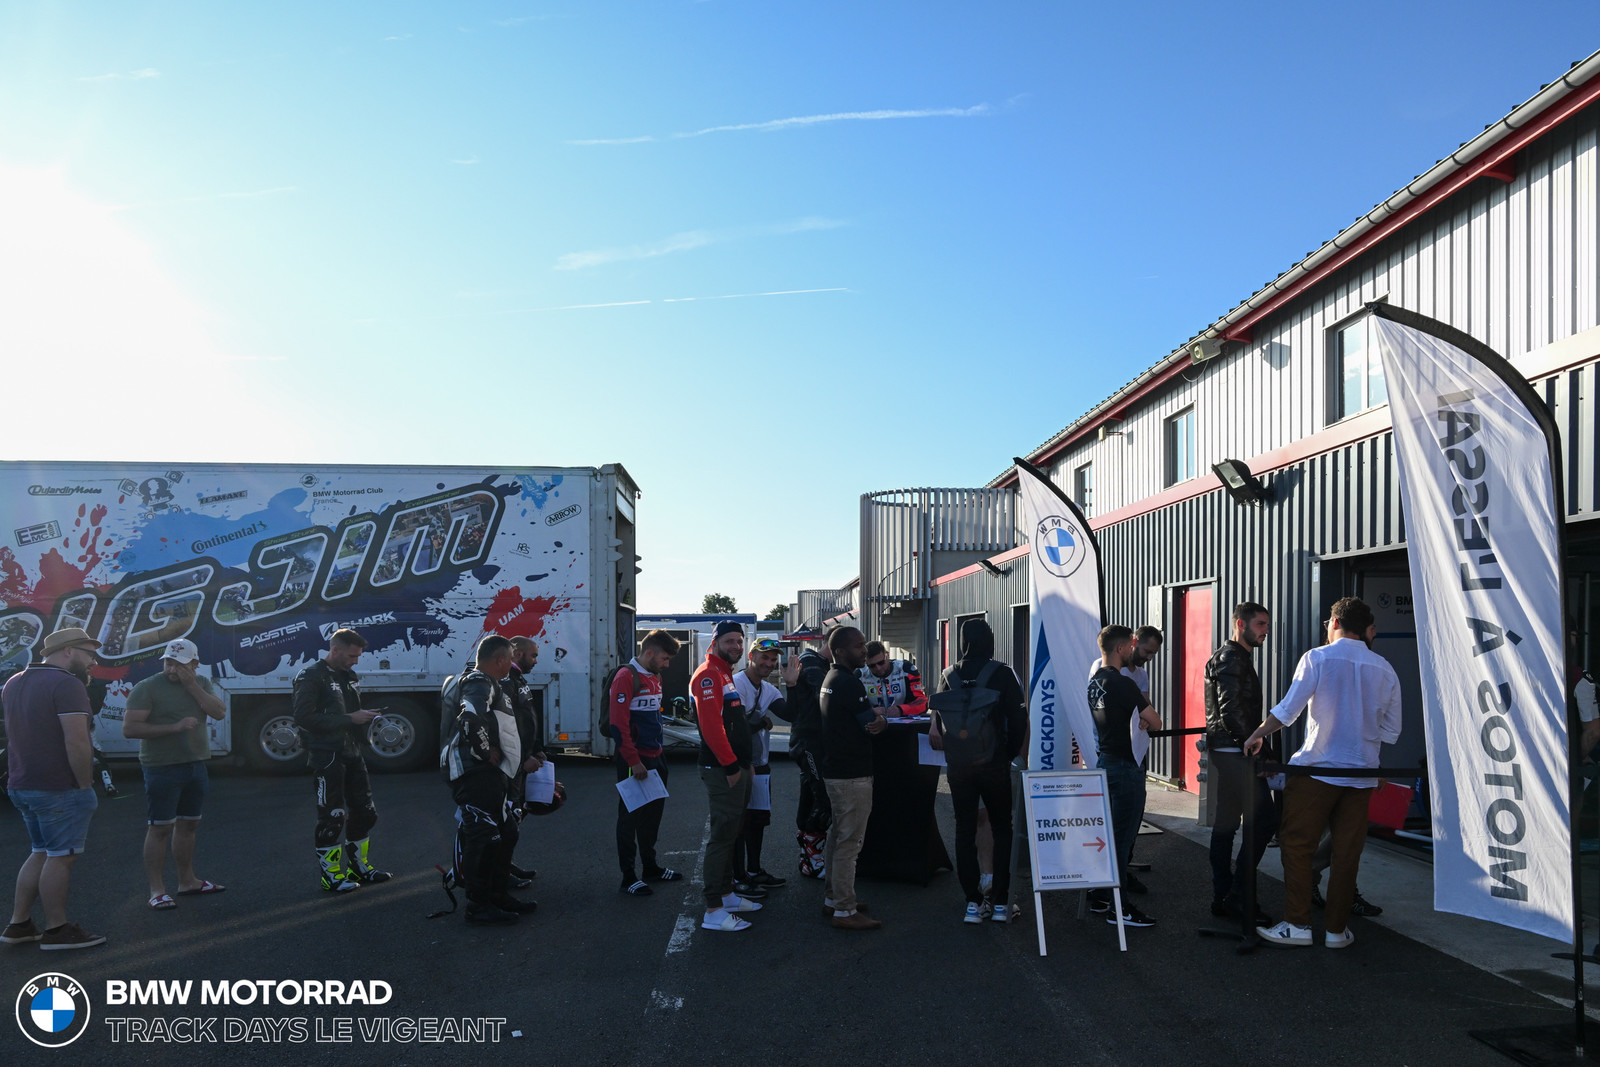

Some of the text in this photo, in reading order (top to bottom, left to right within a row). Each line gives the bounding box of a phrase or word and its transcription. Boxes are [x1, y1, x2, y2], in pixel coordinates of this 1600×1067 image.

[333, 488, 365, 497] Motorrad
[366, 487, 384, 495] Club
[547, 505, 578, 524] ARROW
[191, 523, 257, 554] Continental
[1395, 596, 1413, 606] BM
[498, 603, 525, 626] UAM
[239, 621, 308, 648] BAGSTER
[1036, 817, 1104, 828] TRACKDAYS
[1037, 832, 1066, 841] BMW
